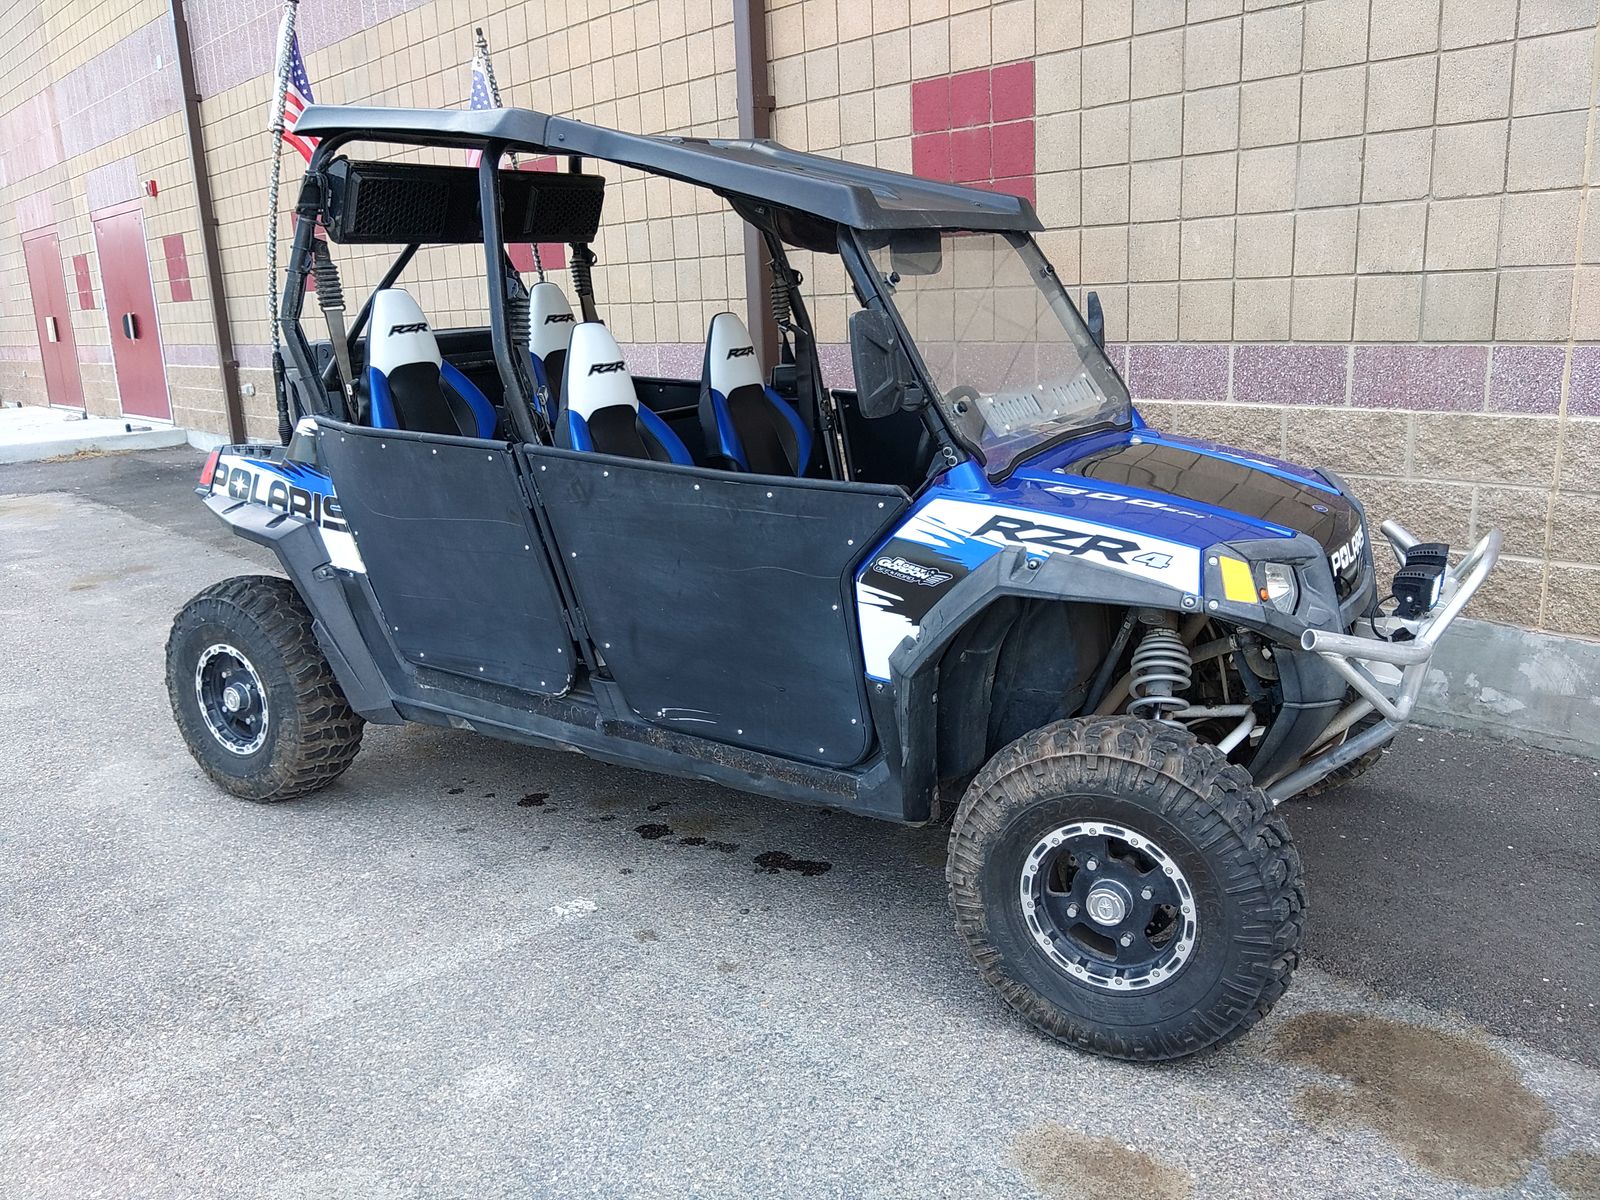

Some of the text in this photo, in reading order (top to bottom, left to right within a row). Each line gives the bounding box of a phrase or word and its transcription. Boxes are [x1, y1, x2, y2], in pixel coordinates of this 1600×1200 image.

[543, 313, 575, 325] RZR
[388, 322, 428, 337] RZR
[726, 346, 754, 360] RZR
[587, 360, 626, 376] RZR
[970, 514, 1174, 570] RZR 4
